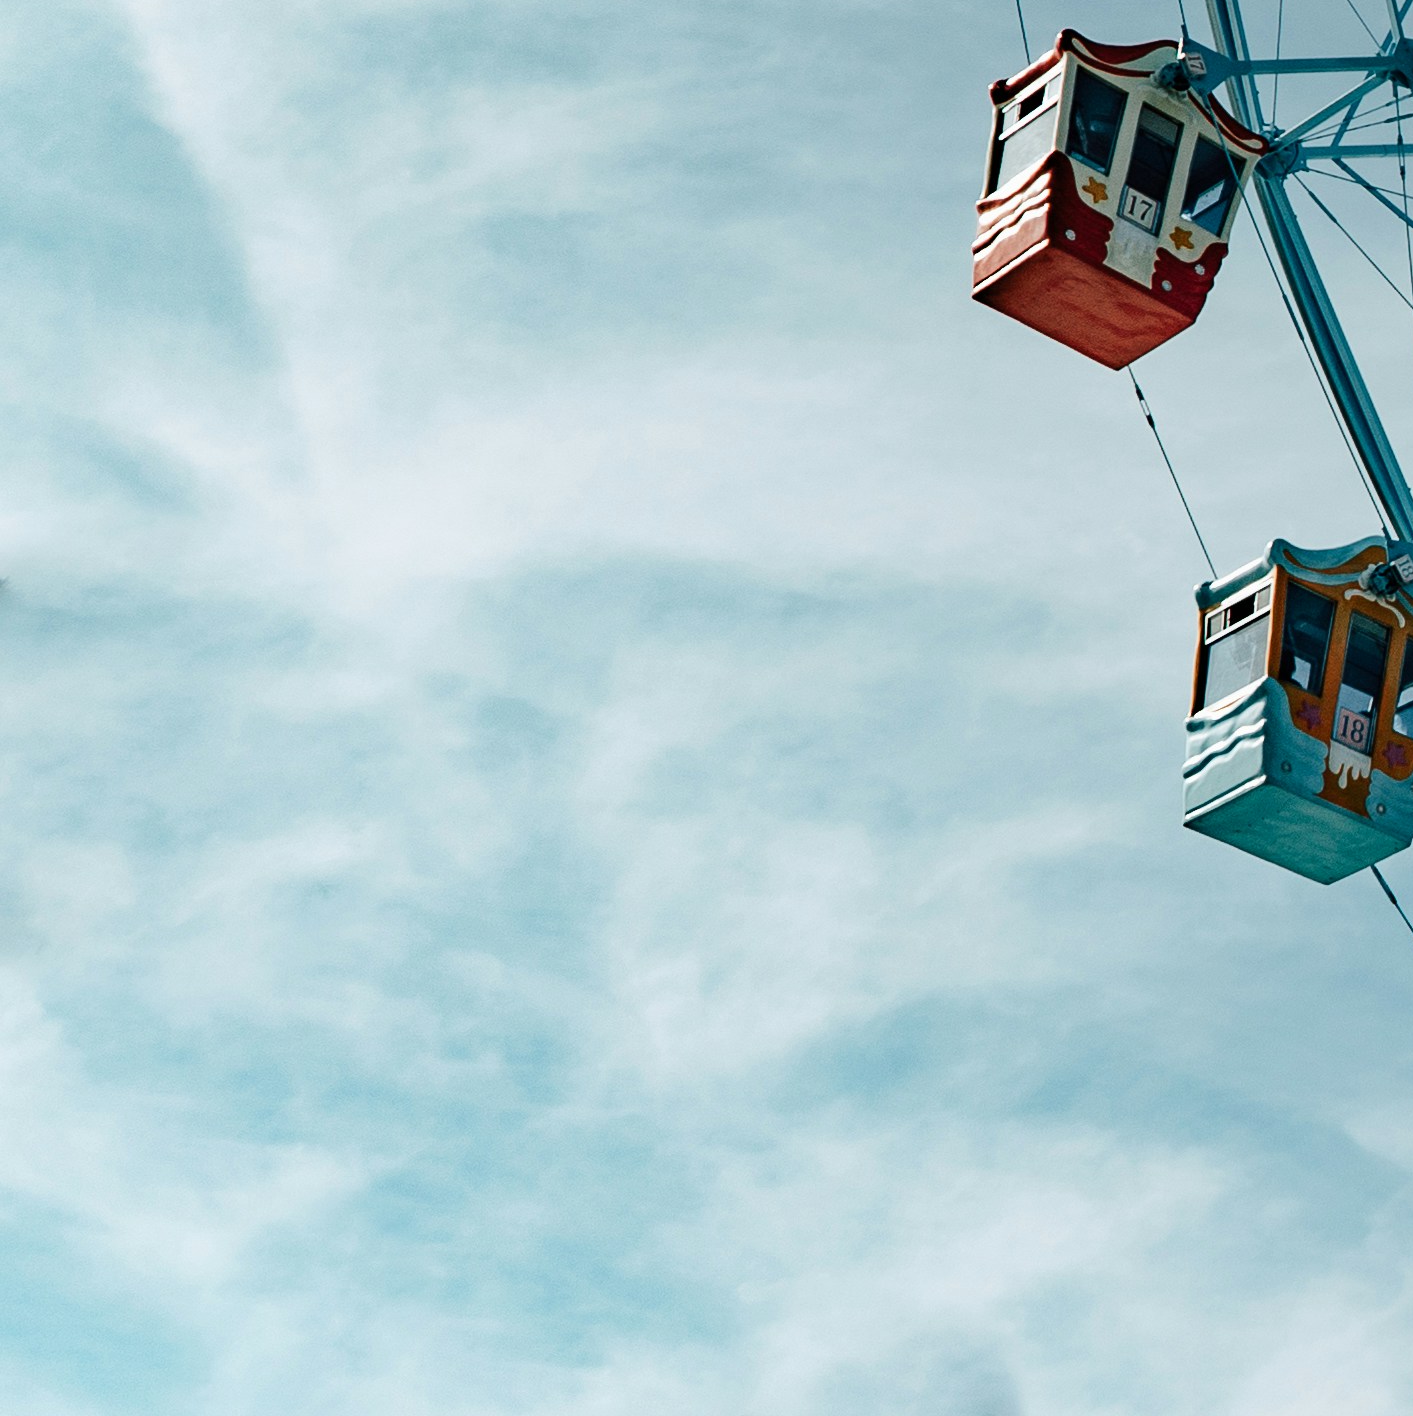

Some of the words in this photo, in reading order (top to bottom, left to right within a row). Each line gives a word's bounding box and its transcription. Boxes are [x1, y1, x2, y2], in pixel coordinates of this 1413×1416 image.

[1187, 55, 1204, 72] 17
[1128, 195, 1153, 221] 17
[1399, 560, 1413, 579] 18
[1341, 714, 1364, 743] 18
